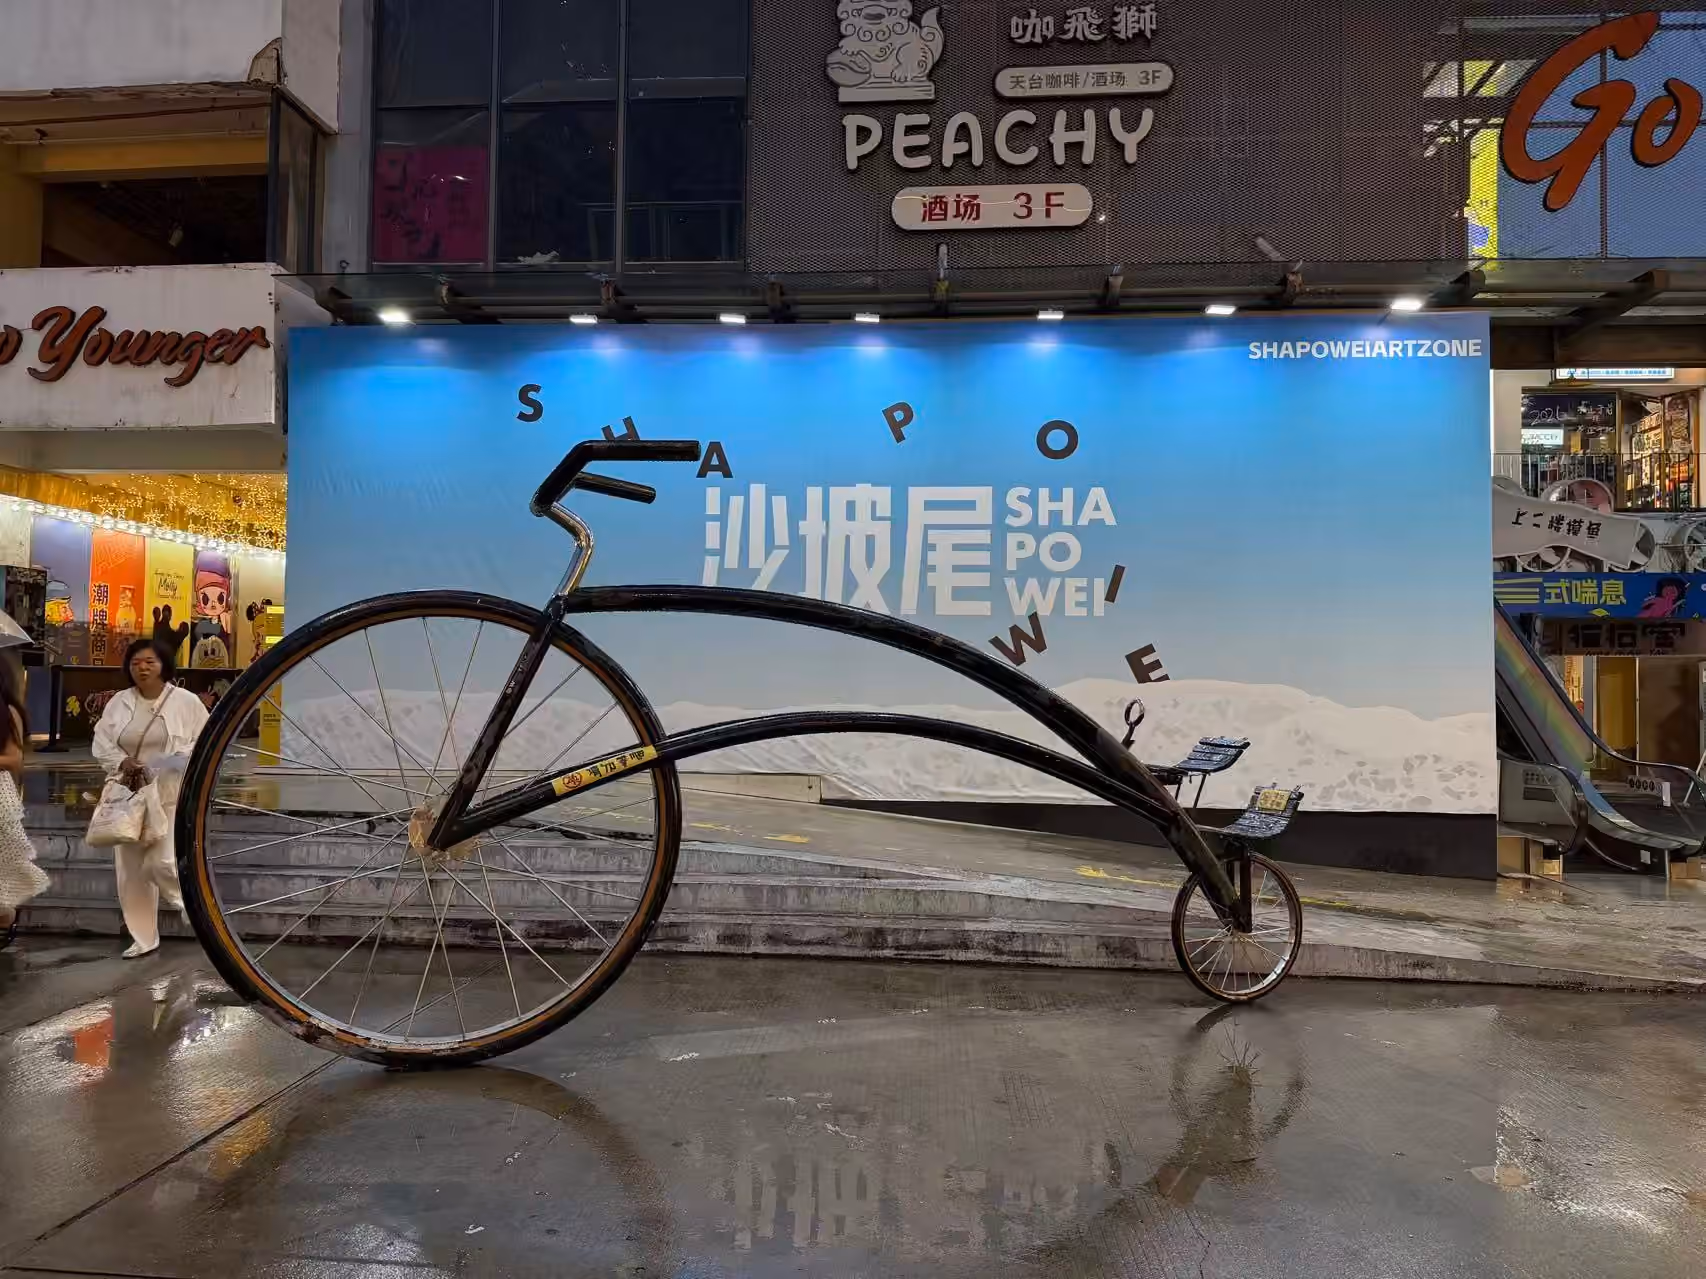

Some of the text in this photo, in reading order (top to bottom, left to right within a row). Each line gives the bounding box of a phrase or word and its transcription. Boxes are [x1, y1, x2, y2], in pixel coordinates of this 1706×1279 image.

[1010, 4, 1157, 44] 咖飛獅
[1009, 69, 1162, 90] 天台咖啡/酒场 3F
[1501, 11, 1704, 212] Go
[842, 107, 1155, 171] PEACHY
[920, 191, 1066, 223] 酒场 3F
[27, 305, 270, 387] Younger
[1248, 339, 1483, 360] SHAPOWEIARTZONE
[695, 441, 734, 479] A
[882, 401, 915, 444] P
[1036, 419, 1079, 460] O
[1004, 486, 1117, 527] SHA
[702, 483, 993, 617] 沙坡尾
[1006, 531, 1082, 572] PO
[1004, 577, 1105, 616] WEI
